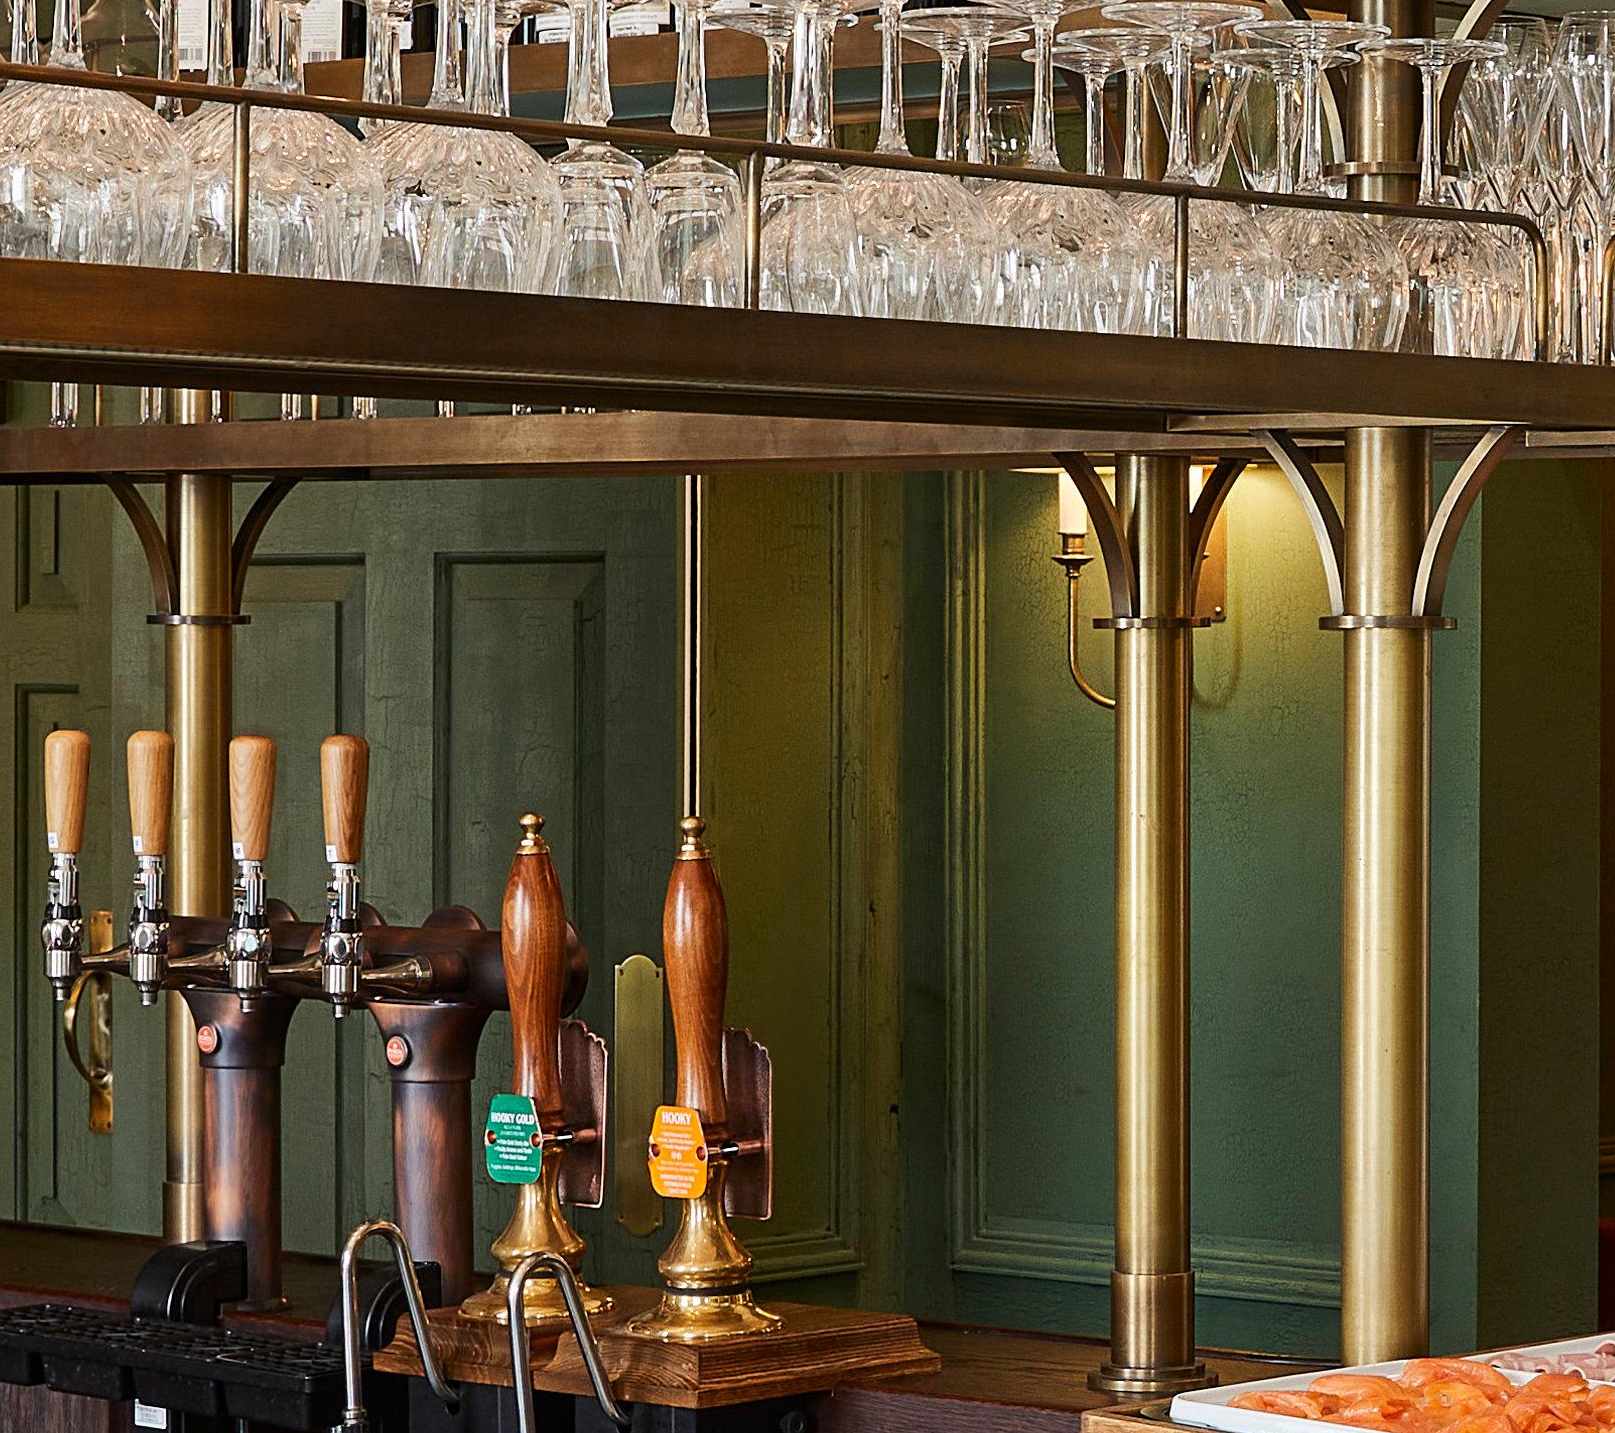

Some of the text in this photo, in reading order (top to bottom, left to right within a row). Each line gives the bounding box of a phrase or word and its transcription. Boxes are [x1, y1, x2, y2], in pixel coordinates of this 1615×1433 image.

[491, 1112, 535, 1126] HOOKY GOLD
[662, 1111, 691, 1125] HOOKY
